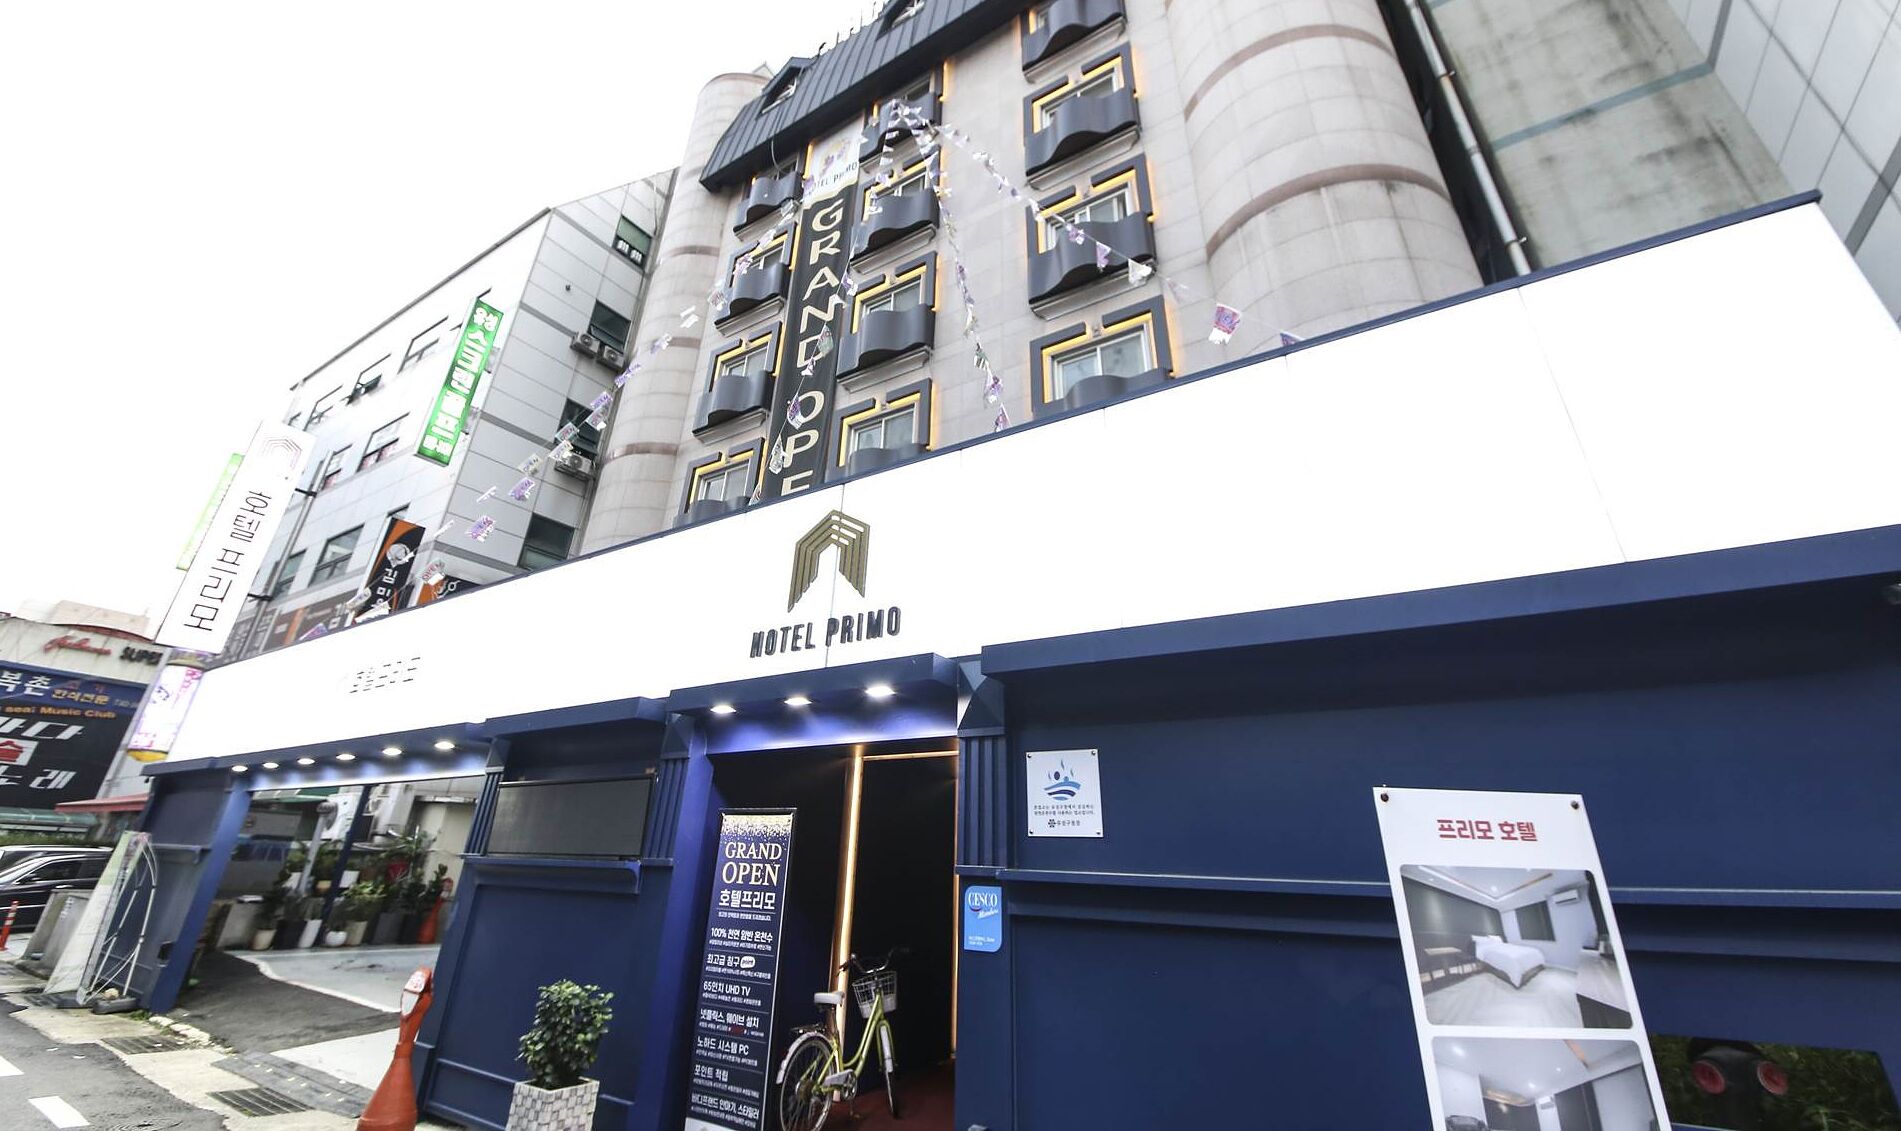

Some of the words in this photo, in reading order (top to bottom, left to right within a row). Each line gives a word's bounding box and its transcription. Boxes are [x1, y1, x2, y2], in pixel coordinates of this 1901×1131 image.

[797, 198, 846, 370] GRAND
[184, 490, 272, 631] 호텔프리모
[750, 622, 816, 658] HOTEL
[825, 606, 901, 647] PRIMO
[40, 706, 82, 717] Music
[84, 709, 117, 719] Club
[1437, 819, 1495, 840] 프리모
[1498, 821, 1538, 842] 호텔
[725, 841, 782, 860] GRAND
[722, 861, 781, 887] OPEN
[719, 889, 776, 910] 호텔프리모
[968, 891, 998, 908] CESCO
[711, 927, 727, 938] 100%
[754, 931, 773, 943] 온천수
[707, 954, 726, 966] 최고급
[703, 980, 725, 993] 65인치
[725, 983, 740, 995] UHD
[741, 986, 751, 997] TV
[697, 1036, 717, 1050] 노하드
[717, 1040, 738, 1054] 시스템
[738, 1043, 749, 1056] PC
[694, 1064, 714, 1079] 포인트
